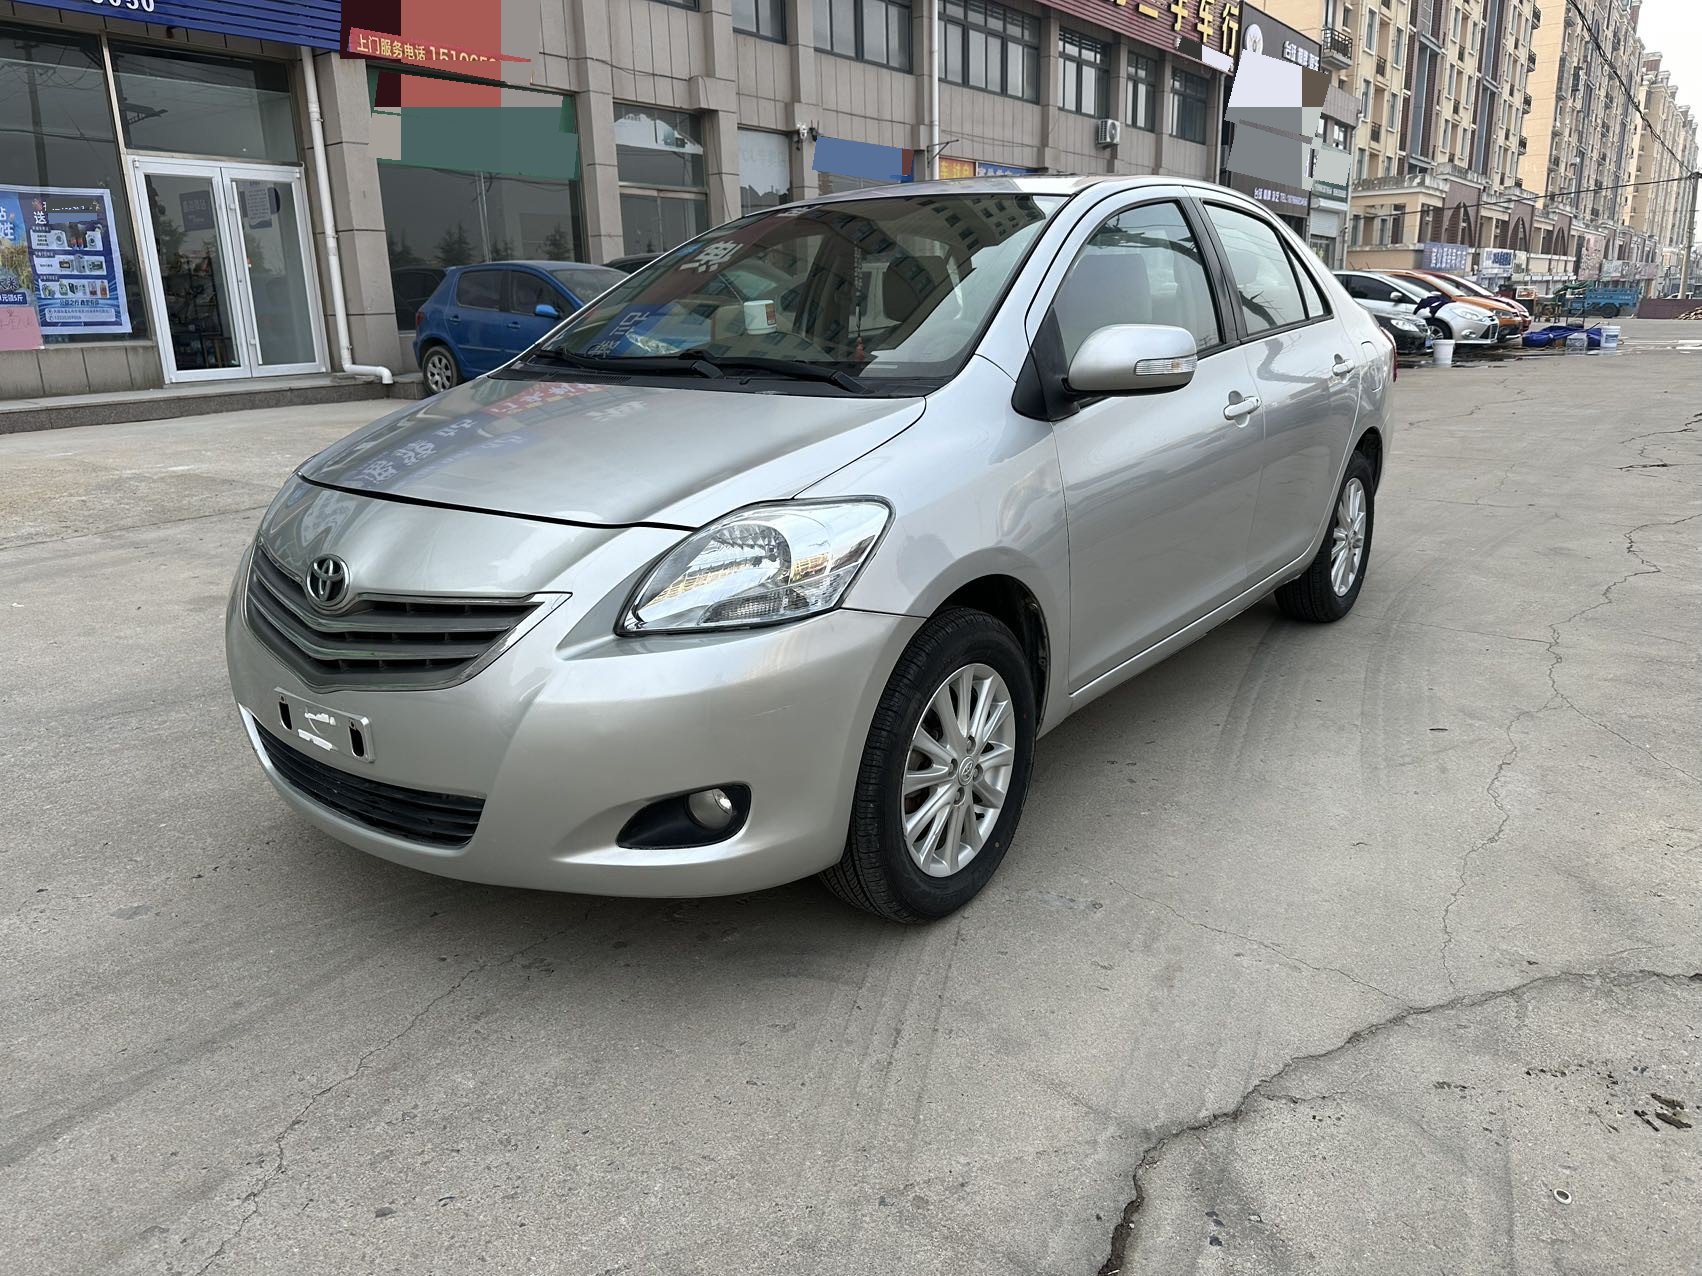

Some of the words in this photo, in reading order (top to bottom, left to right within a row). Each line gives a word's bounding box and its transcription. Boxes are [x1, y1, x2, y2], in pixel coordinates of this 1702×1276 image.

[356, 33, 426, 61] 上门服务电话
[1116, 0, 1239, 56] 二手车行
